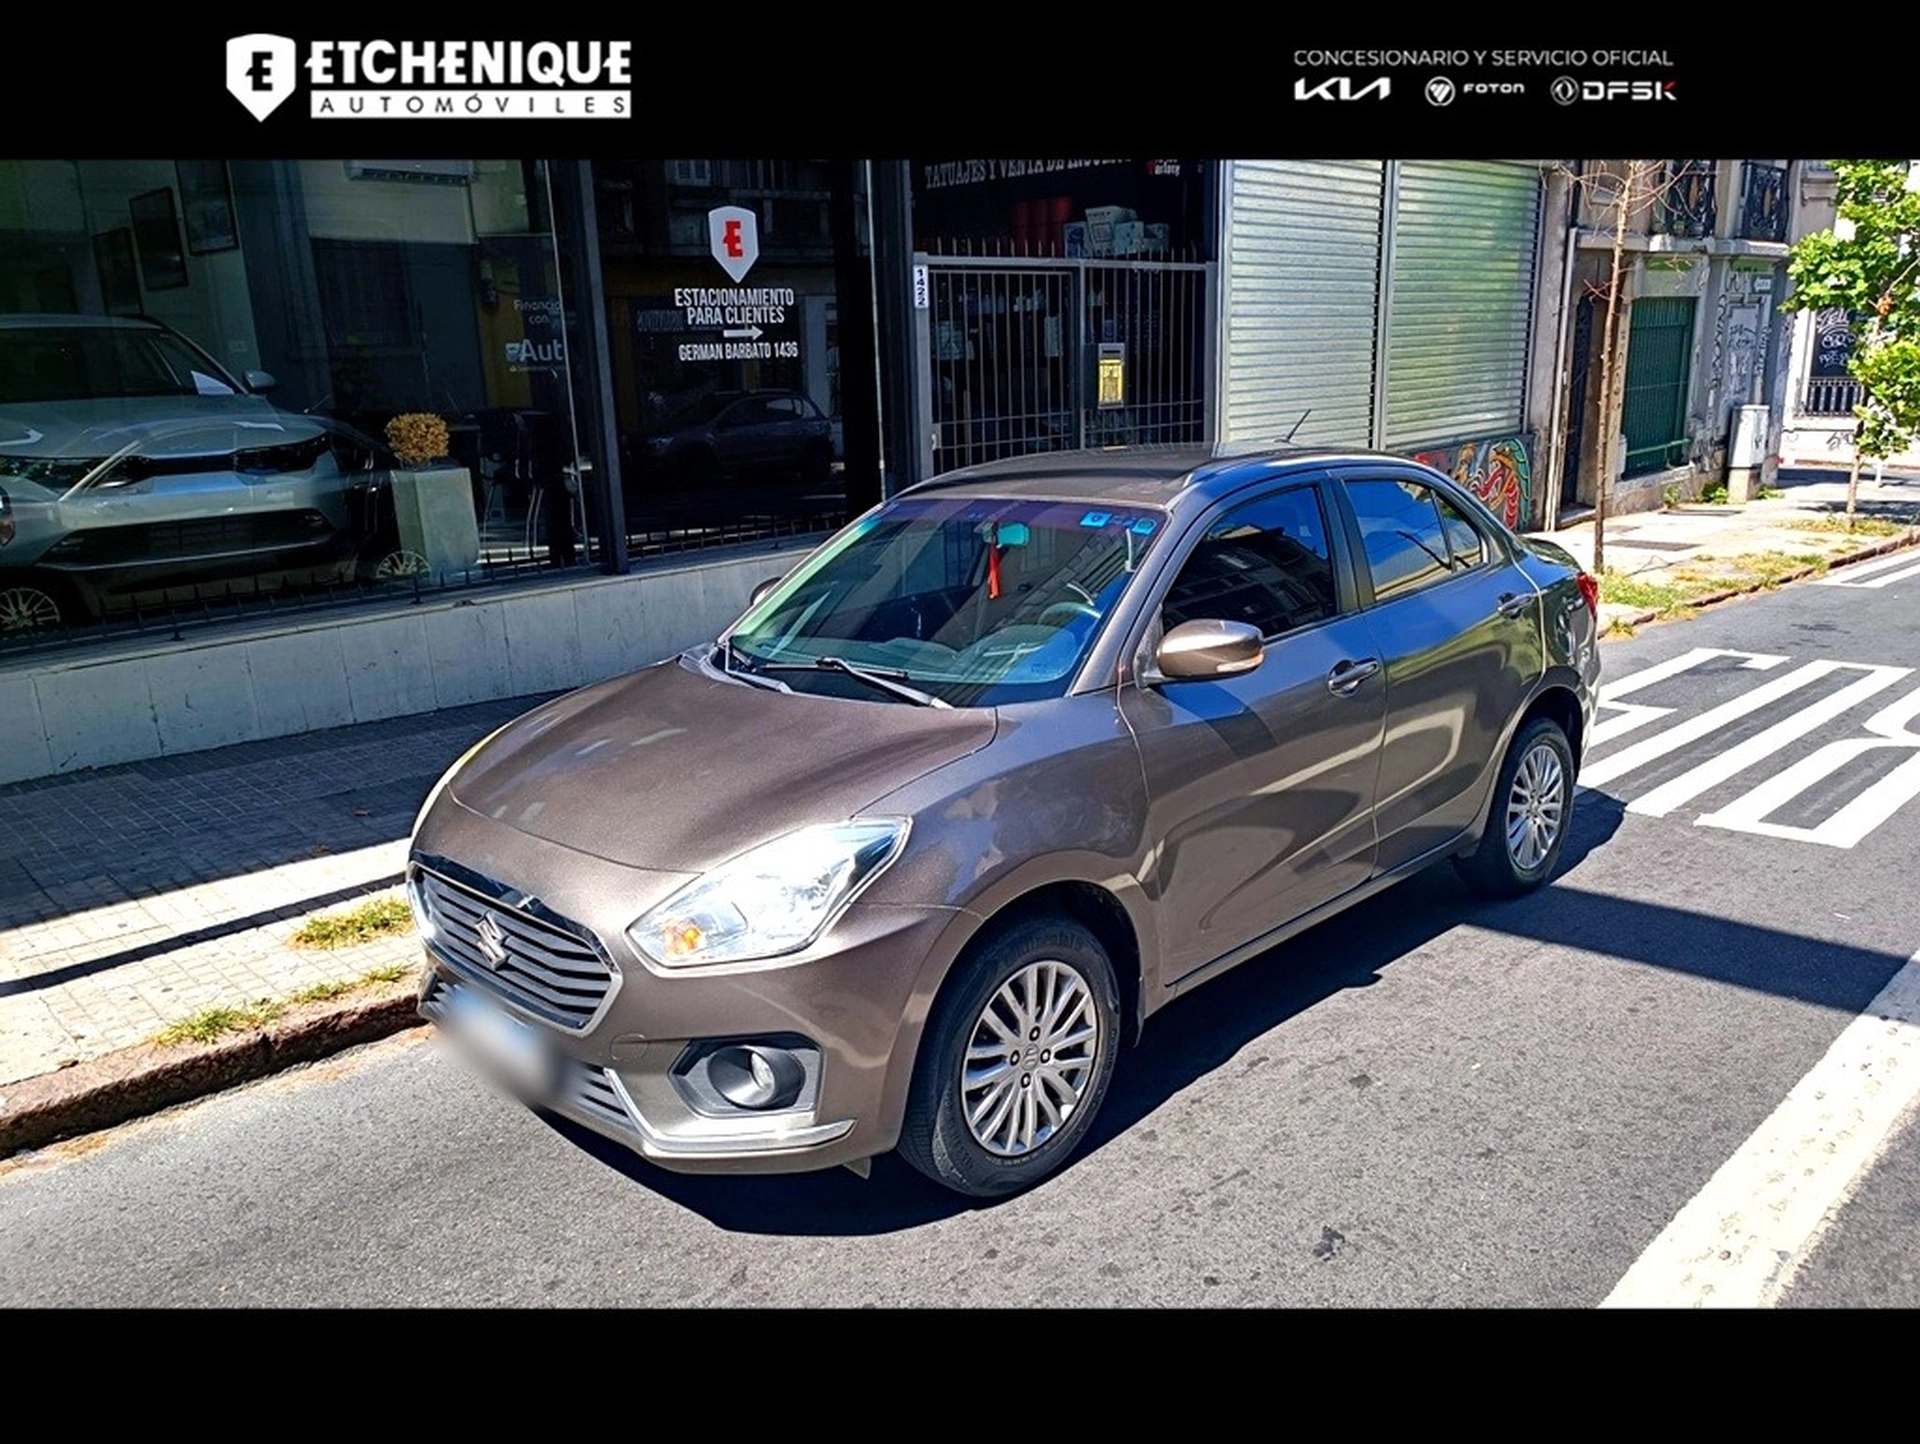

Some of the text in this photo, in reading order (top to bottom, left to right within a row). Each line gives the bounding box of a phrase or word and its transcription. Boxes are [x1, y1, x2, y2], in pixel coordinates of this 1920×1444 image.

[674, 287, 795, 307] ESTACIONAMIENTO
[916, 268, 925, 306] 1422
[686, 307, 723, 326] PARA
[725, 305, 785, 325] CLIENTES
[678, 341, 799, 362] GERMAN BARBATO 1436
